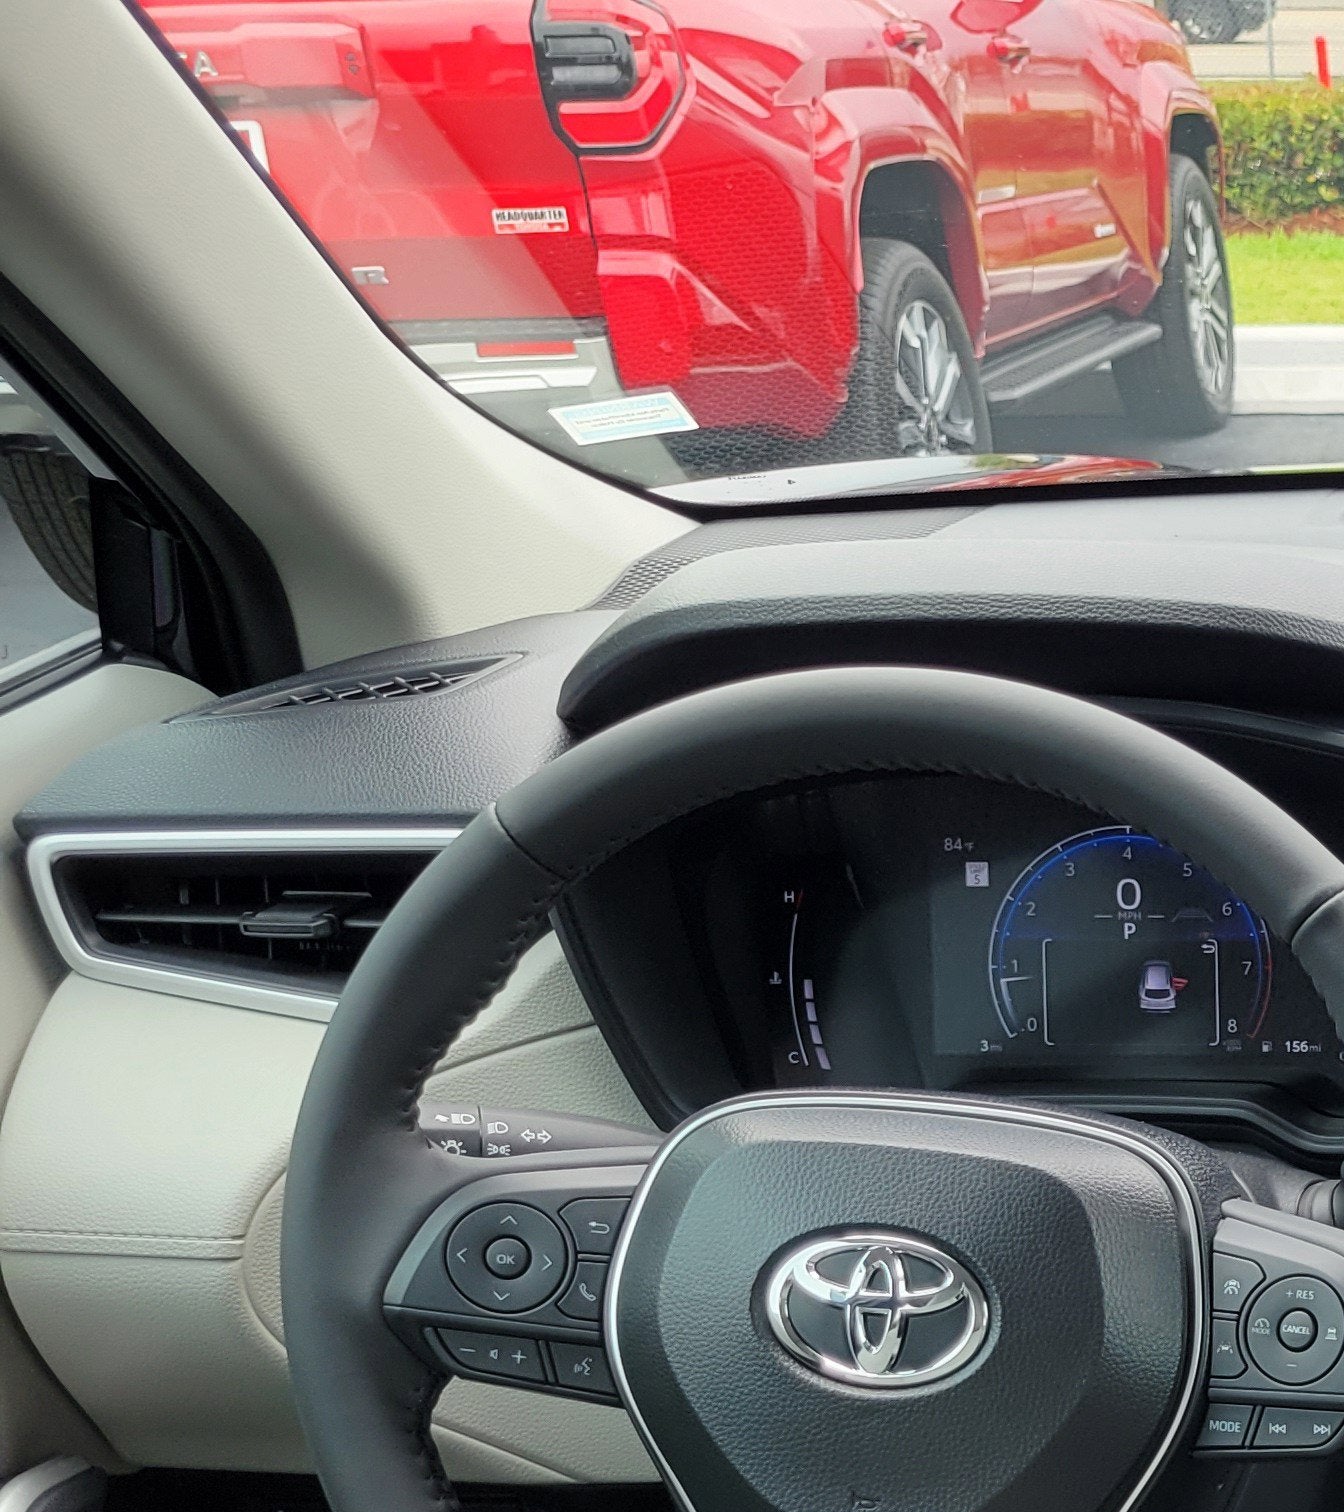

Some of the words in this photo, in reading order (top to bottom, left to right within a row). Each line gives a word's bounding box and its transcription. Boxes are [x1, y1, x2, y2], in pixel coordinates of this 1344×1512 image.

[1122, 848, 1132, 861] 4
[1065, 863, 1075, 877] 3
[1182, 862, 1193, 877] 5
[784, 891, 795, 904] H
[1116, 878, 1141, 910] 0
[1025, 902, 1036, 916] 2
[1117, 912, 1142, 920] MPH
[1222, 902, 1232, 916] 6
[1123, 923, 1137, 940] P
[1012, 959, 1018, 973] 1
[1241, 961, 1252, 975] 7
[1027, 1018, 1037, 1032] 0
[1227, 1019, 1238, 1033] 8
[788, 1051, 799, 1065] C
[496, 1253, 516, 1266] OK
[1282, 1325, 1310, 1335] CANCEL
[1209, 1420, 1241, 1433] MODE
